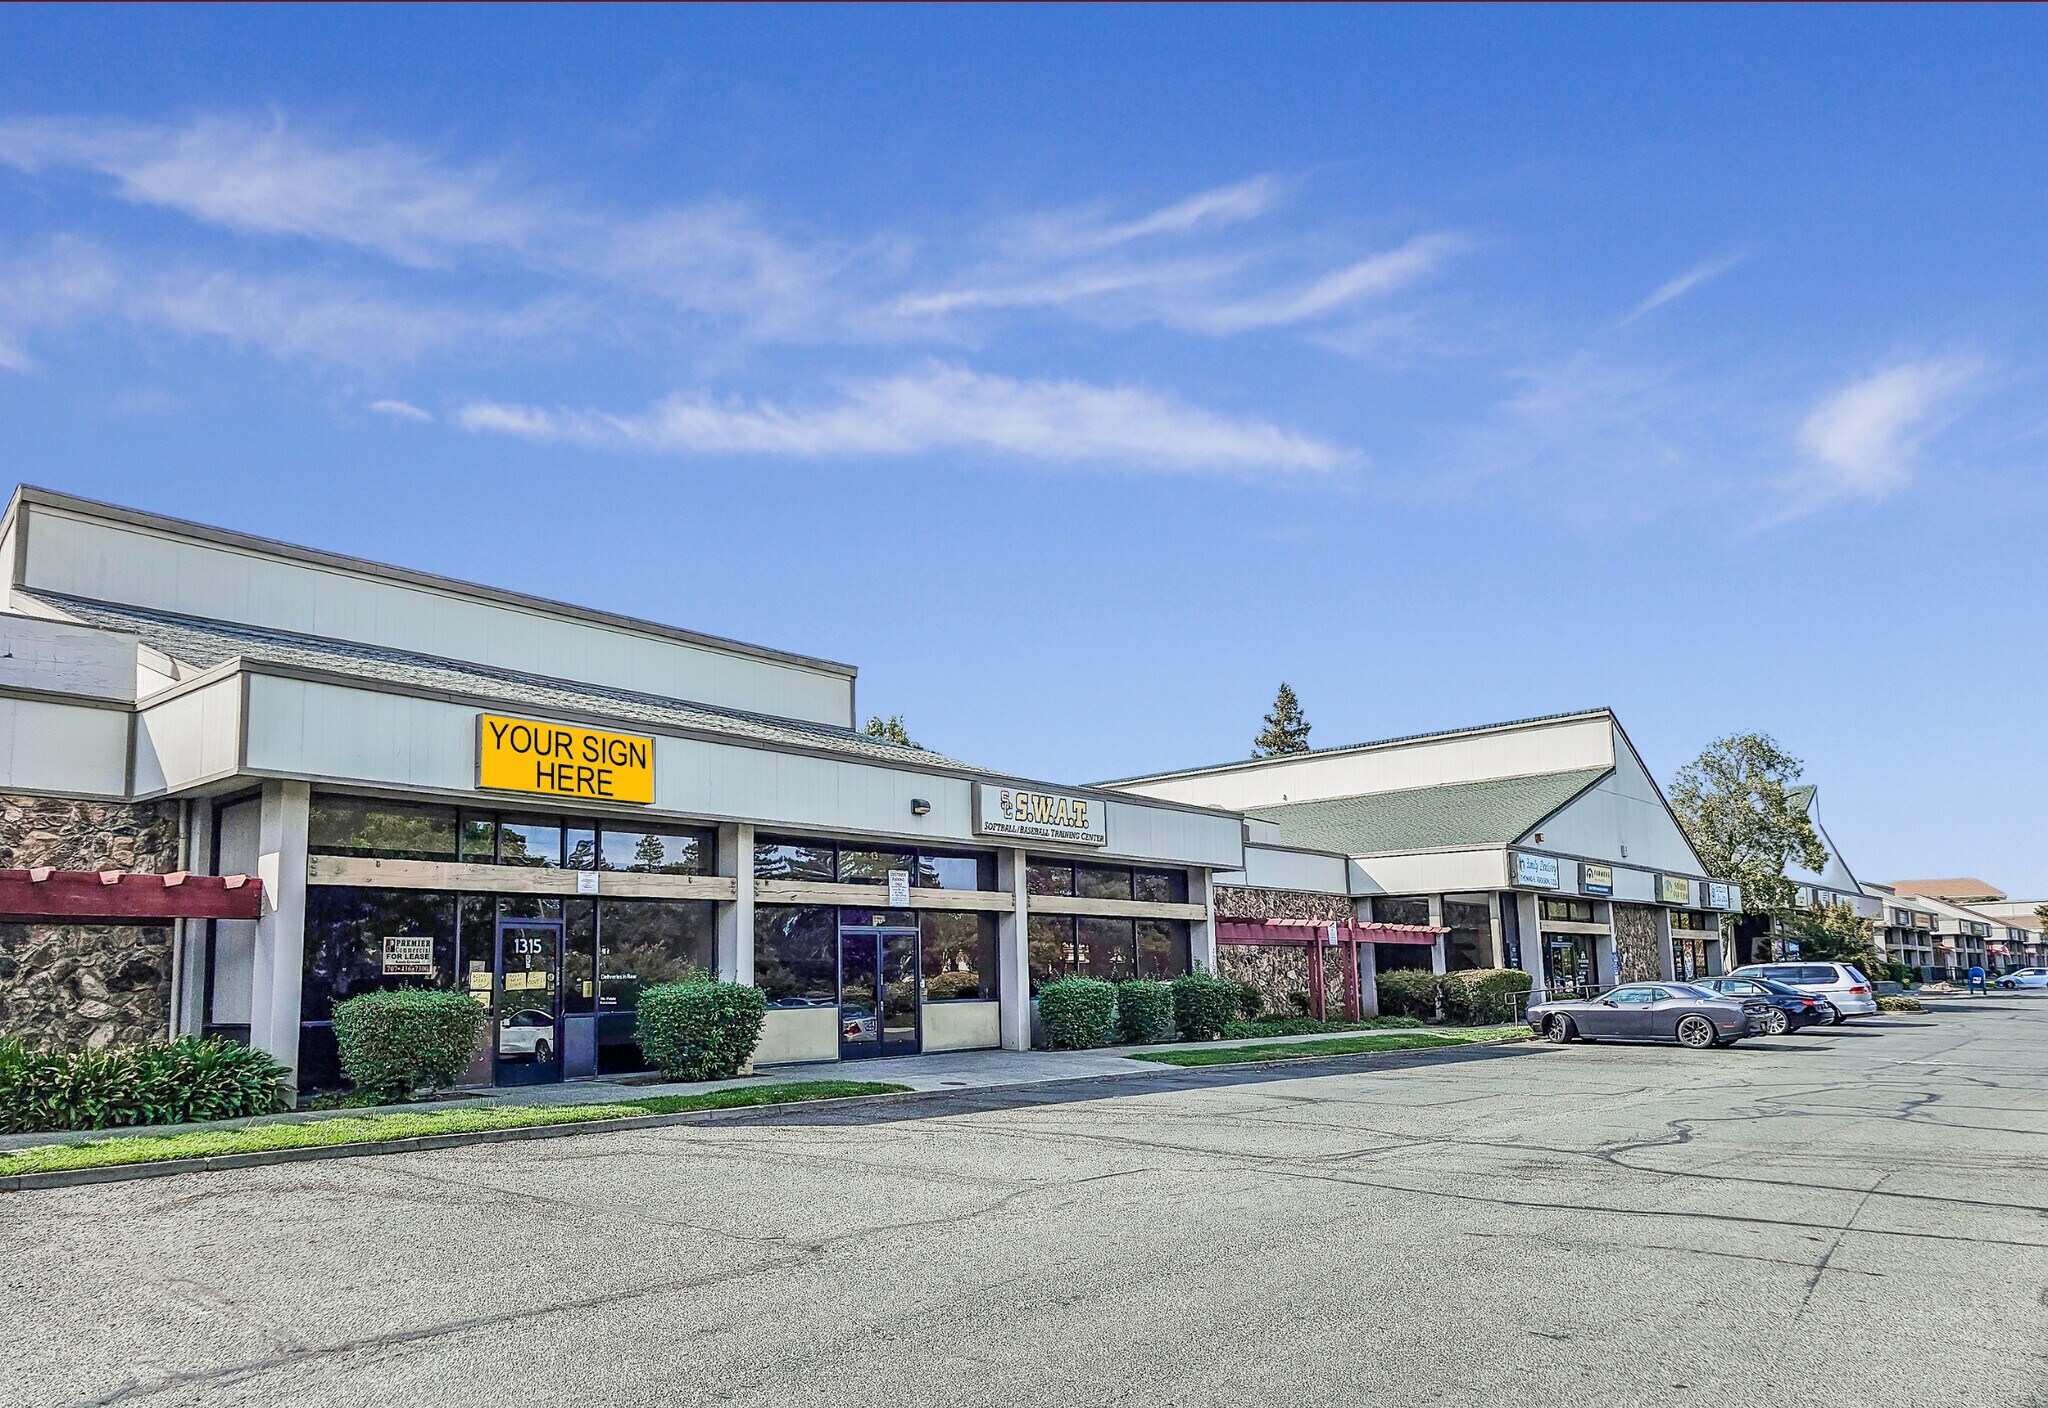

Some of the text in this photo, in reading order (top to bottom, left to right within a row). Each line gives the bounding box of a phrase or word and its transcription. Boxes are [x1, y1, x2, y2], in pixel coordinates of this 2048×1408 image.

[489, 721, 646, 769] YOUR SIGN
[537, 760, 613, 796] HERE
[1015, 792, 1089, 829] S.W.A.T.
[1050, 828, 1080, 840] TRAINING
[1081, 832, 1105, 842] CENTER
[396, 939, 431, 947] PREMIER
[514, 938, 542, 954] 1315
